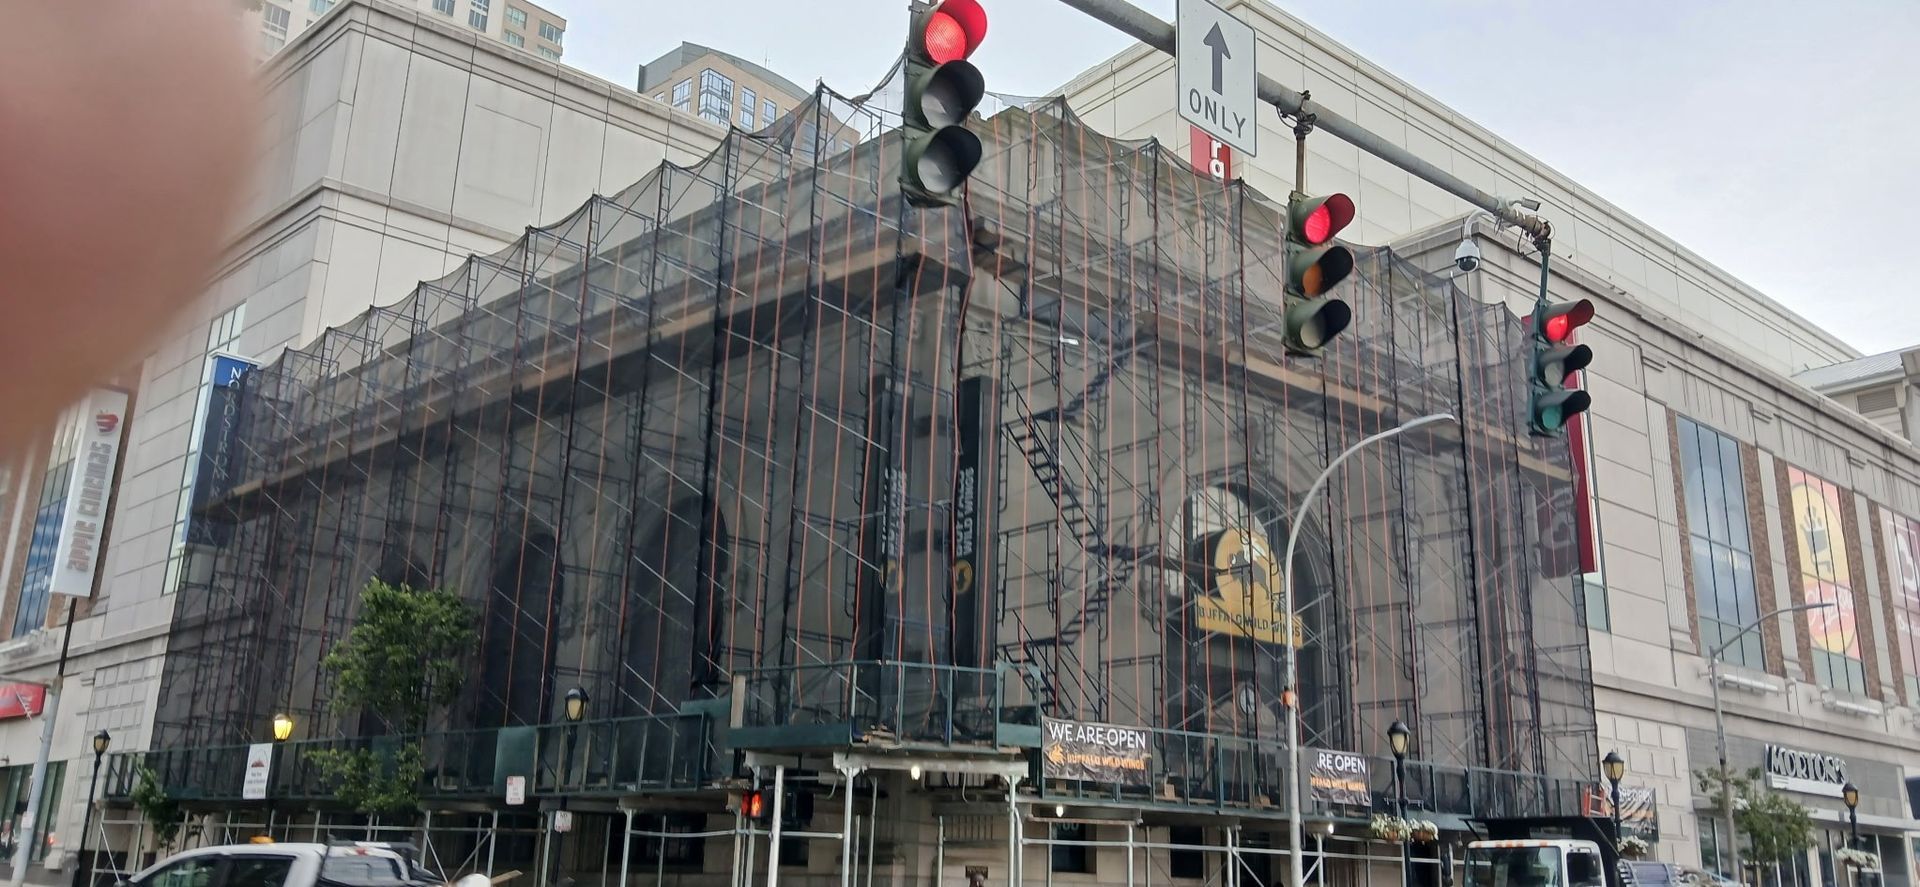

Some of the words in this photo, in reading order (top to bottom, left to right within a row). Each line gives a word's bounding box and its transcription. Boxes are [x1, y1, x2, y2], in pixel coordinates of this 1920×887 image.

[1189, 87, 1247, 139] ONLY
[964, 467, 974, 515] WINGS
[963, 517, 973, 555] WILD
[1199, 607, 1242, 625] BUFFAO
[1272, 621, 1301, 637] WNS
[1048, 721, 1073, 742] WE
[1076, 725, 1104, 745] ARE
[1107, 728, 1146, 749] OPEN
[1316, 752, 1333, 771] RE
[1335, 755, 1366, 775] OPEN
[1771, 743, 1848, 786] MORTON'S
